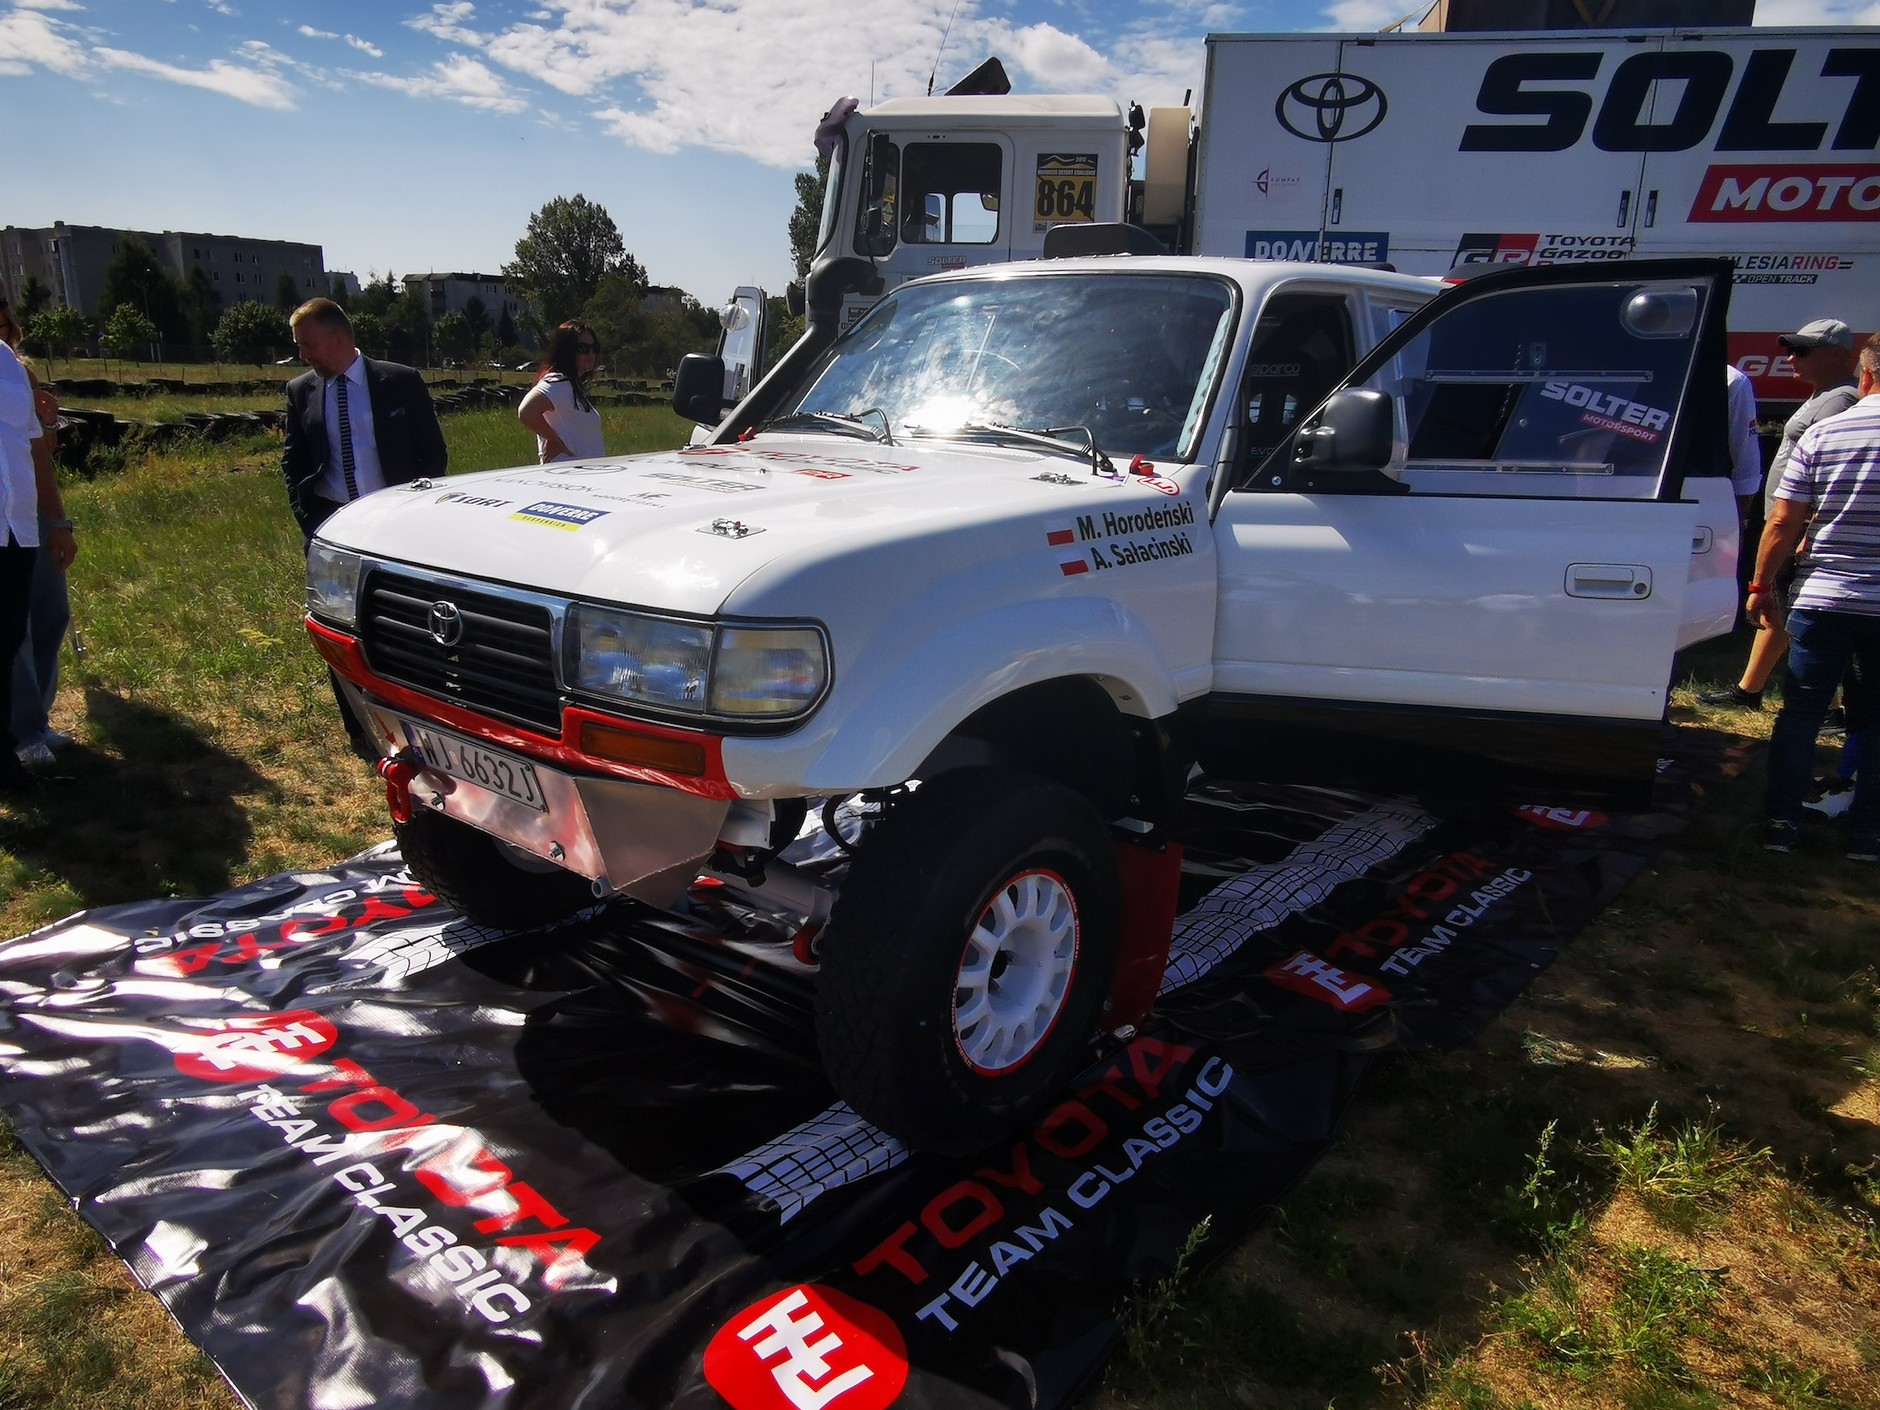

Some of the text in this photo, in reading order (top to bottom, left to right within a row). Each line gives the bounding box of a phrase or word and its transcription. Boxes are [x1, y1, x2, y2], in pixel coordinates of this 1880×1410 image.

[1037, 180, 1094, 217] 864
[1711, 176, 1880, 211] MOTO
[1539, 249, 1625, 259] GAZOO
[1546, 235, 1637, 246] TOYOTA
[928, 256, 967, 265] SOLTER
[1750, 275, 1815, 284] OPEN TRACK
[1251, 363, 1300, 377] sparco
[1540, 381, 1670, 432] SOLTER
[1582, 414, 1657, 442] MOTORSPORT
[1076, 501, 1194, 541] M. Horodeński
[1090, 547, 1113, 571] A.
[459, 745, 534, 803] 6632J
[1324, 852, 1497, 959] TOYOTA
[1380, 867, 1533, 977] TEAM CLASSIC
[852, 1036, 1197, 1285] TOYOTA
[237, 1083, 532, 1323] TEAM CLASSIC
[915, 1056, 1234, 1332] TEAM CLASSIC
